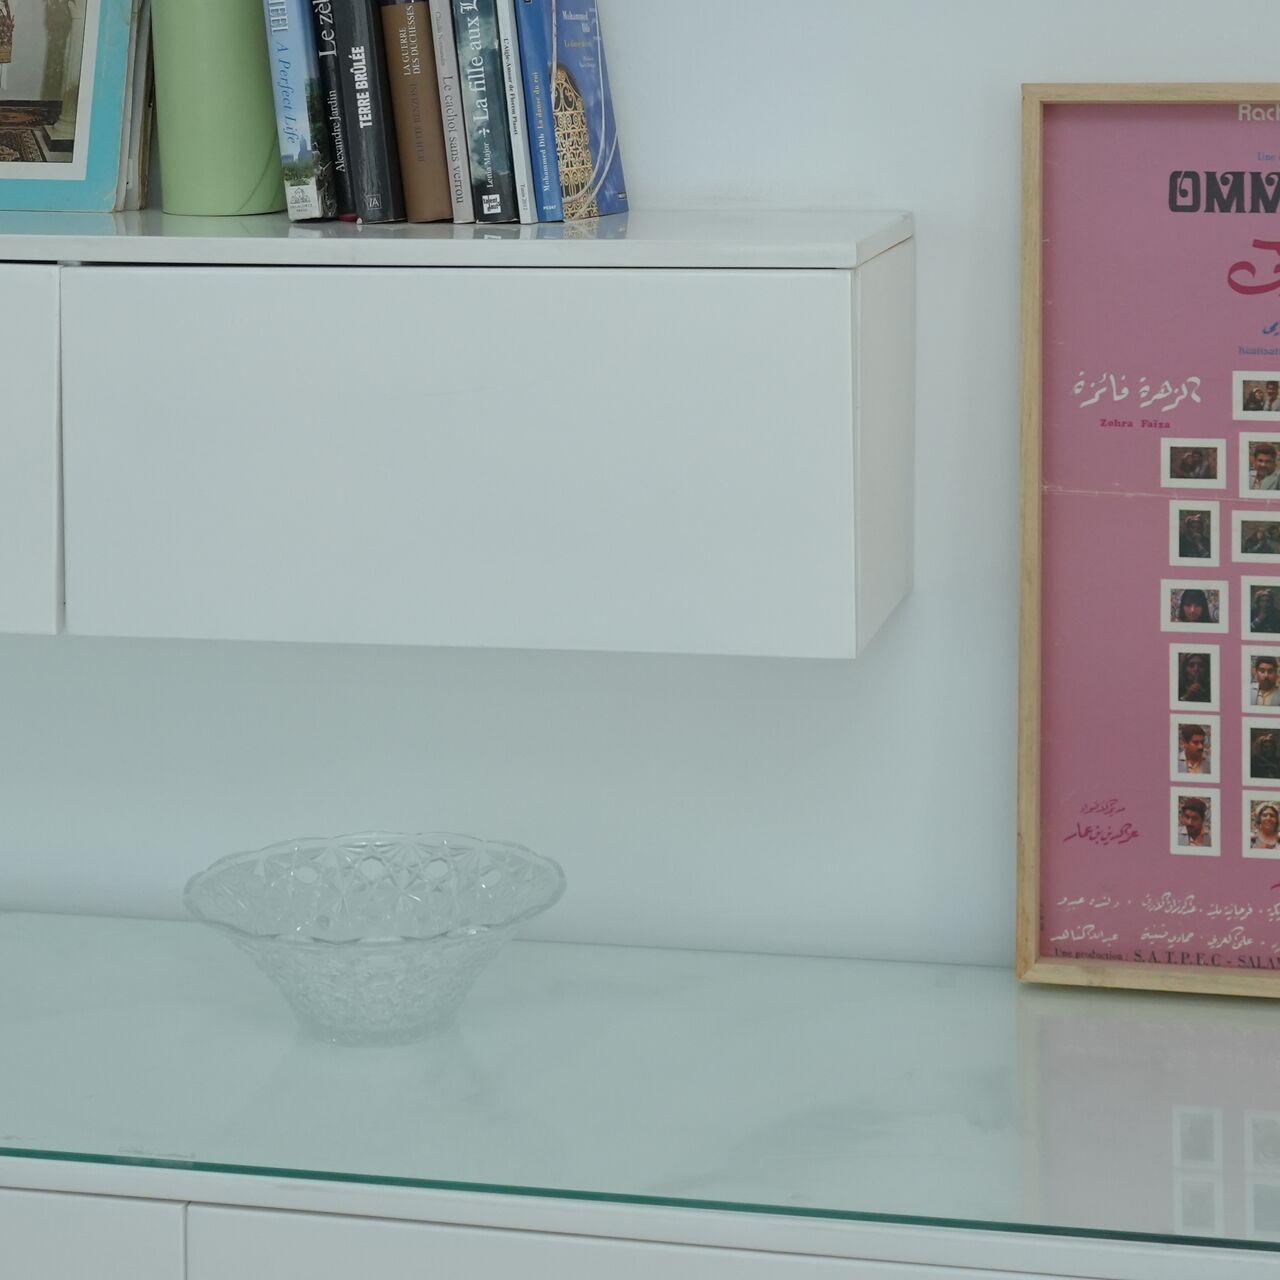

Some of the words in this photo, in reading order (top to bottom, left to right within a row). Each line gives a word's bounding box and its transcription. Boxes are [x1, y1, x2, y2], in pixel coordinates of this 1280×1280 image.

[319, 30, 337, 57] Le
[399, 26, 410, 60] GUERRE
[406, 5, 419, 55] DUCHESSES
[467, 16, 483, 50] aux
[277, 58, 295, 109] Perfect
[349, 45, 369, 90] BRÛLÉE
[402, 62, 411, 75] LA
[411, 57, 421, 76] DES
[443, 75, 453, 91] Le
[468, 56, 487, 92] fille
[327, 89, 342, 121] Jardin
[356, 91, 372, 129] TERRE
[444, 96, 458, 131] cachot
[474, 98, 489, 120] La
[284, 114, 299, 144] Life
[332, 121, 346, 172] Alexandre
[448, 136, 458, 162] sans
[483, 142, 492, 170] Major
[453, 165, 464, 204] verrou
[1073, 371, 1129, 408] فائزة
[1140, 376, 1201, 412] الزهرة
[1100, 419, 1133, 427] Zohra
